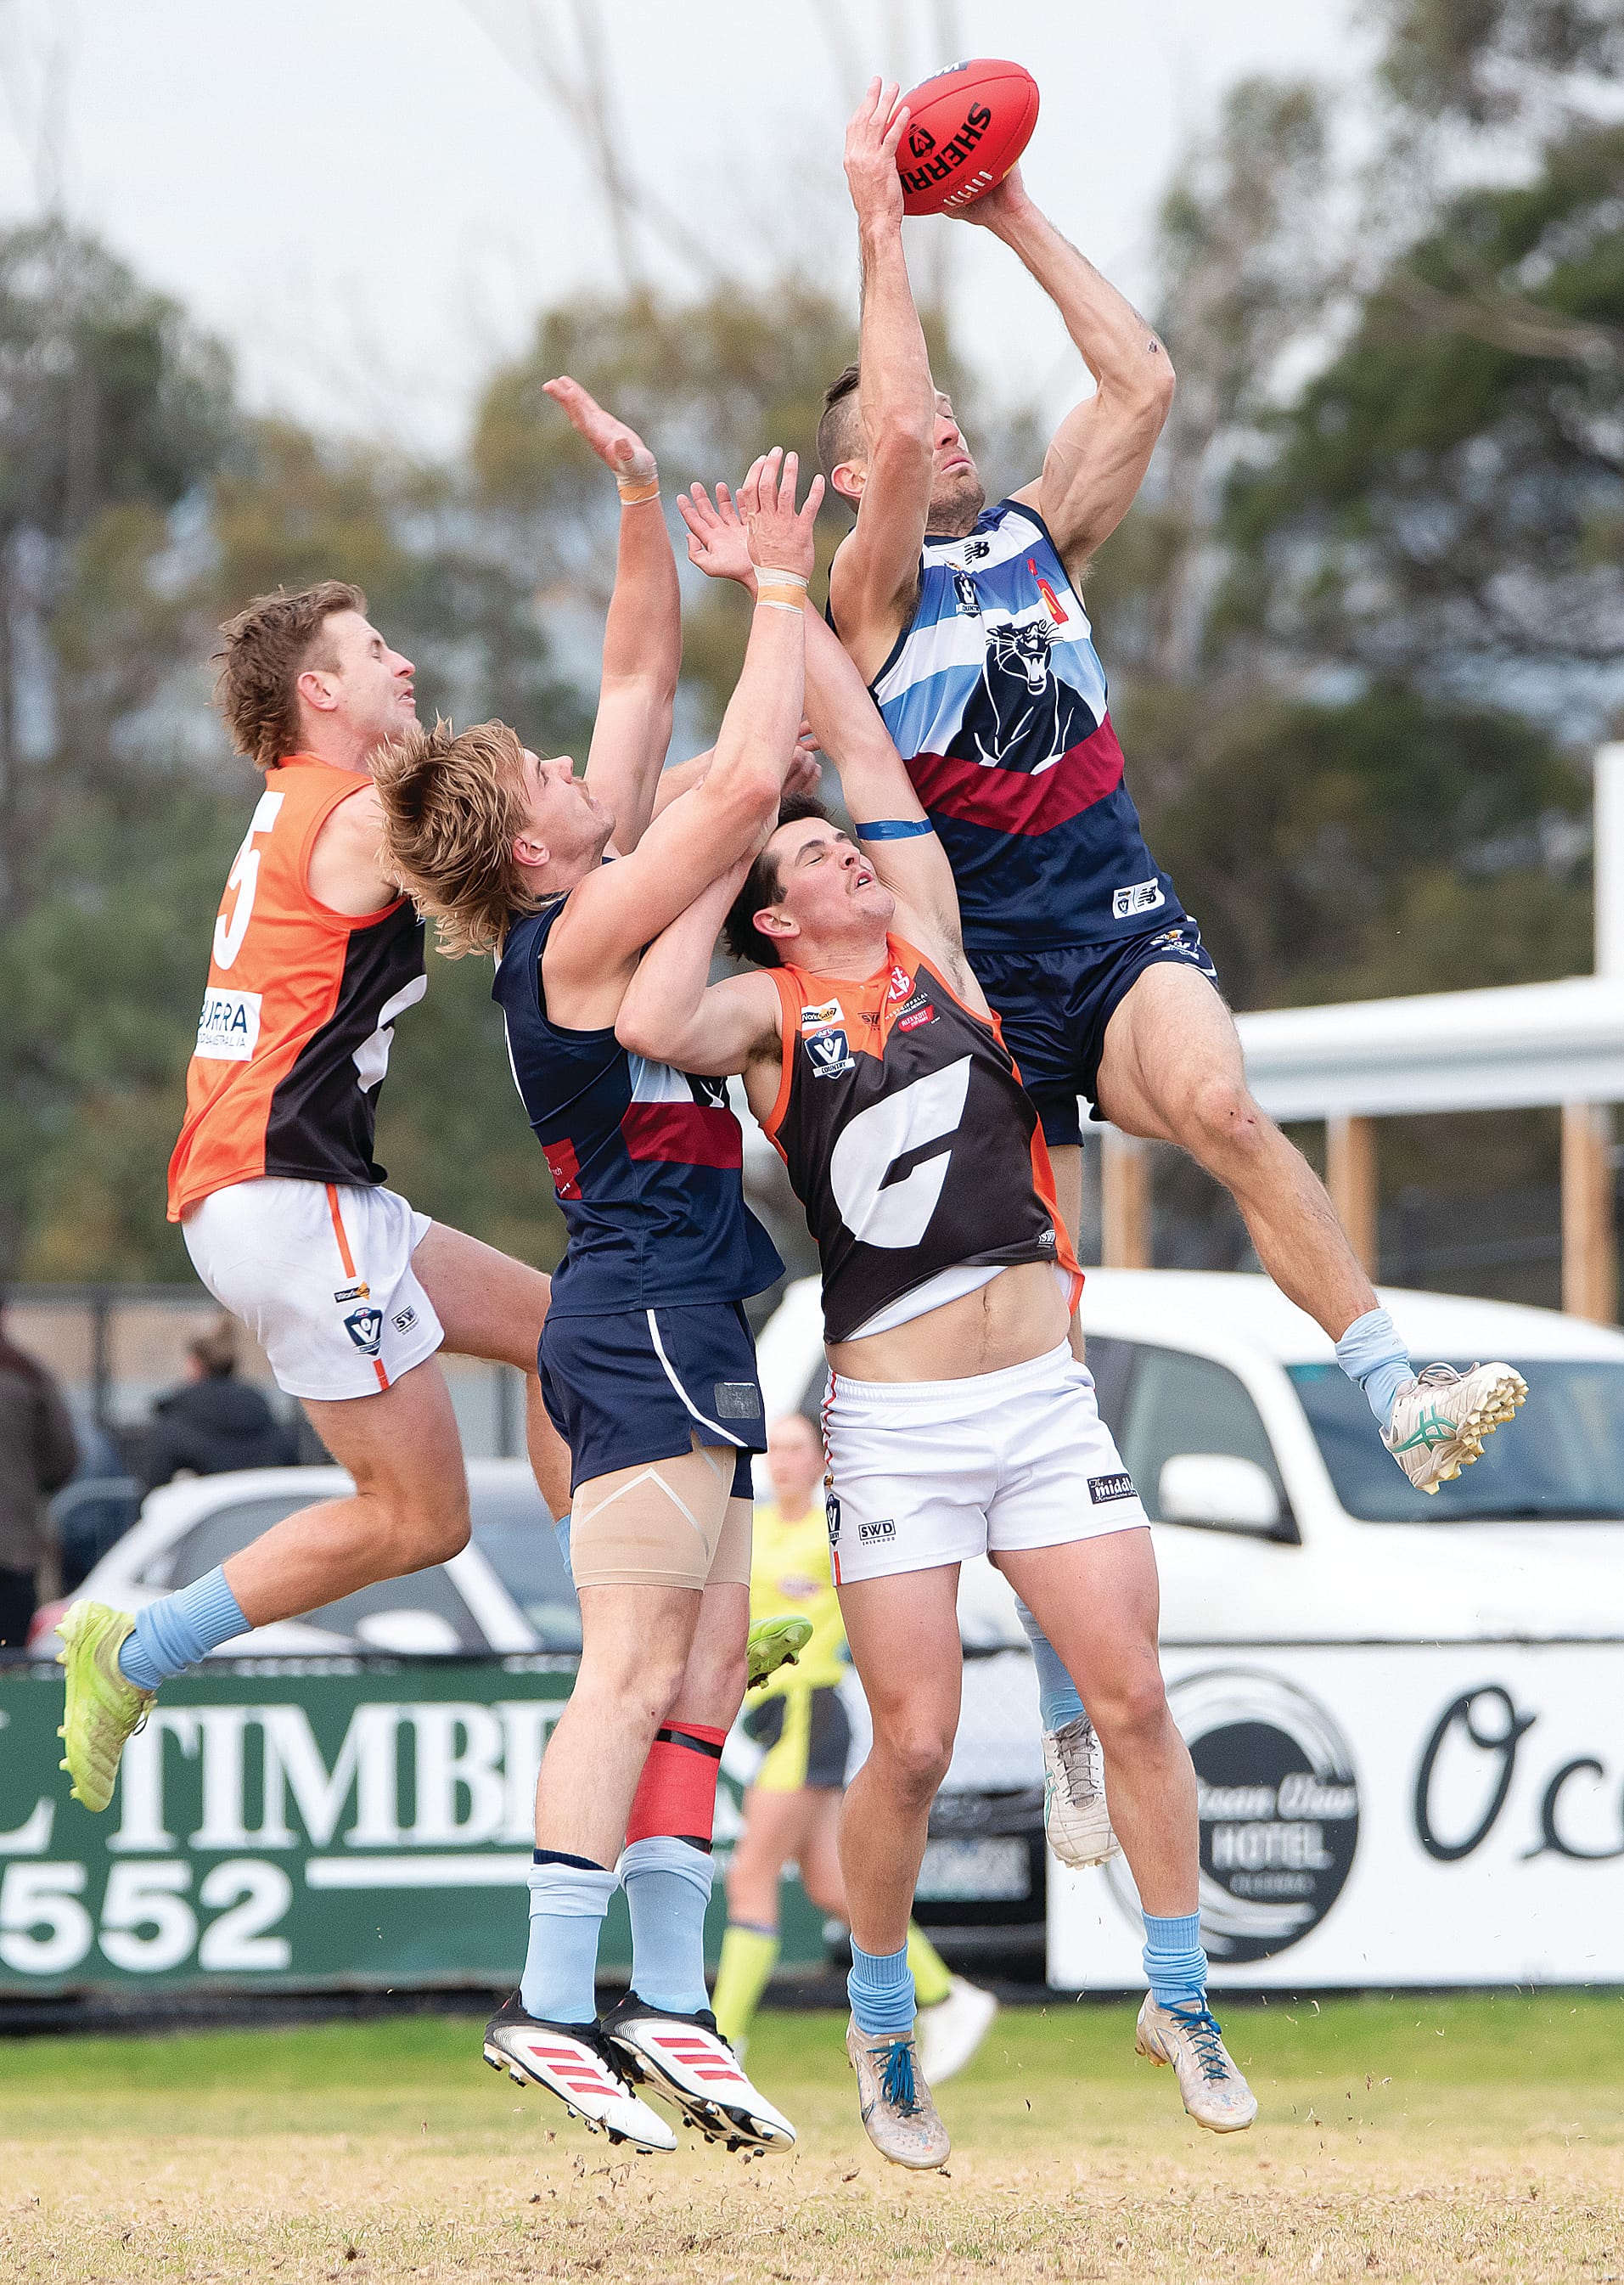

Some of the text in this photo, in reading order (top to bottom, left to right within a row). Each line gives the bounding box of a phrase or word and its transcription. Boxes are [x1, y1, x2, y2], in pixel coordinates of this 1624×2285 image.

[900, 102, 992, 194] SHERRI
[861, 1522, 893, 1538] SWD
[1416, 1686, 1624, 1861] Oc
